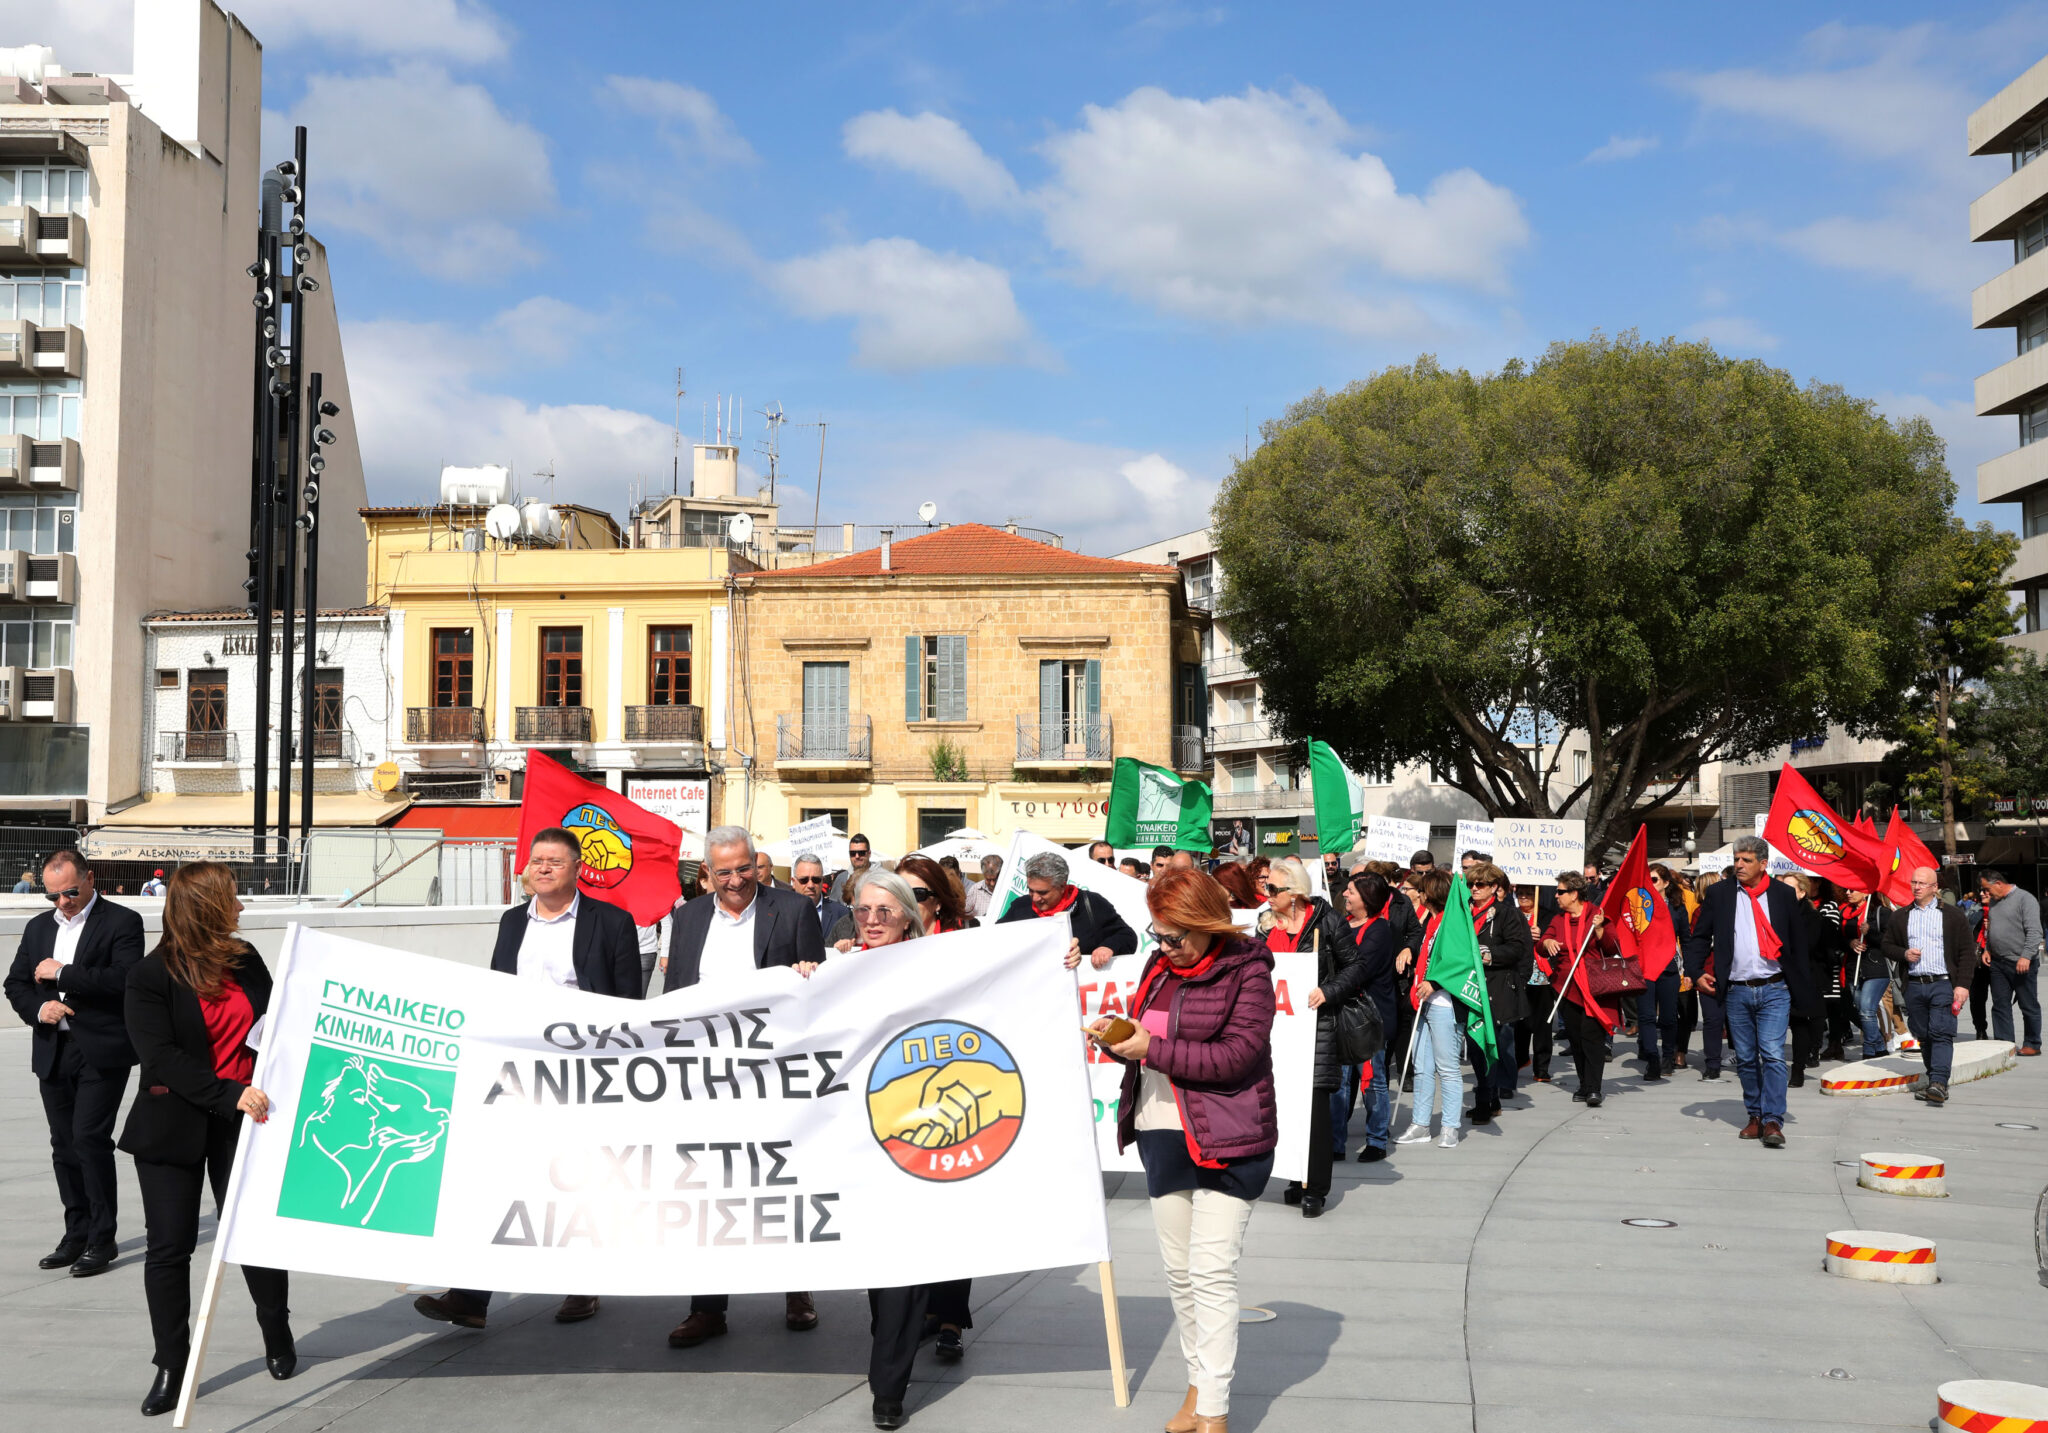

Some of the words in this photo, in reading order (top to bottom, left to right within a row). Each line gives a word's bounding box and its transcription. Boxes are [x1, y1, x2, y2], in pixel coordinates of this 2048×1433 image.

[631, 786, 676, 800] Internet
[680, 786, 705, 800] Cafe
[1995, 801, 2014, 811] SHAM
[579, 807, 620, 832] ΠΕΟ
[1136, 823, 1178, 832] ΓΥΝΑΙΚΕΙΟ
[1510, 822, 1531, 834] ΟΧΙ
[1540, 823, 1564, 835] ΣΤΟ
[1809, 813, 1837, 836] ΠΕΟ
[1263, 831, 1292, 844] SUBWAY
[1497, 838, 1535, 848] ΧΑΣΜΑ
[1539, 838, 1584, 850] ΑΜΟΙΒΩΝ
[1513, 851, 1531, 861] ΟΧΙ
[1536, 851, 1557, 861] ΣΤΟ
[1500, 865, 1522, 875] ΑΣΜΑ
[322, 979, 465, 1031] ΓΥΝΑΙΚΕΙΟ
[314, 1012, 395, 1051] ΚΙΝΗΜΑ
[401, 1034, 460, 1062] ΠΟΓΟ
[543, 1021, 645, 1051] ΟΧΙ
[650, 1007, 774, 1050] ΣΤΙΣ
[902, 1031, 981, 1065] ΠΕΟ
[483, 1050, 850, 1105] ΑΝΙΣΟΤΗΤΕΣ
[673, 1140, 798, 1190] ΣΤΙΣ
[929, 1144, 984, 1171] 1941
